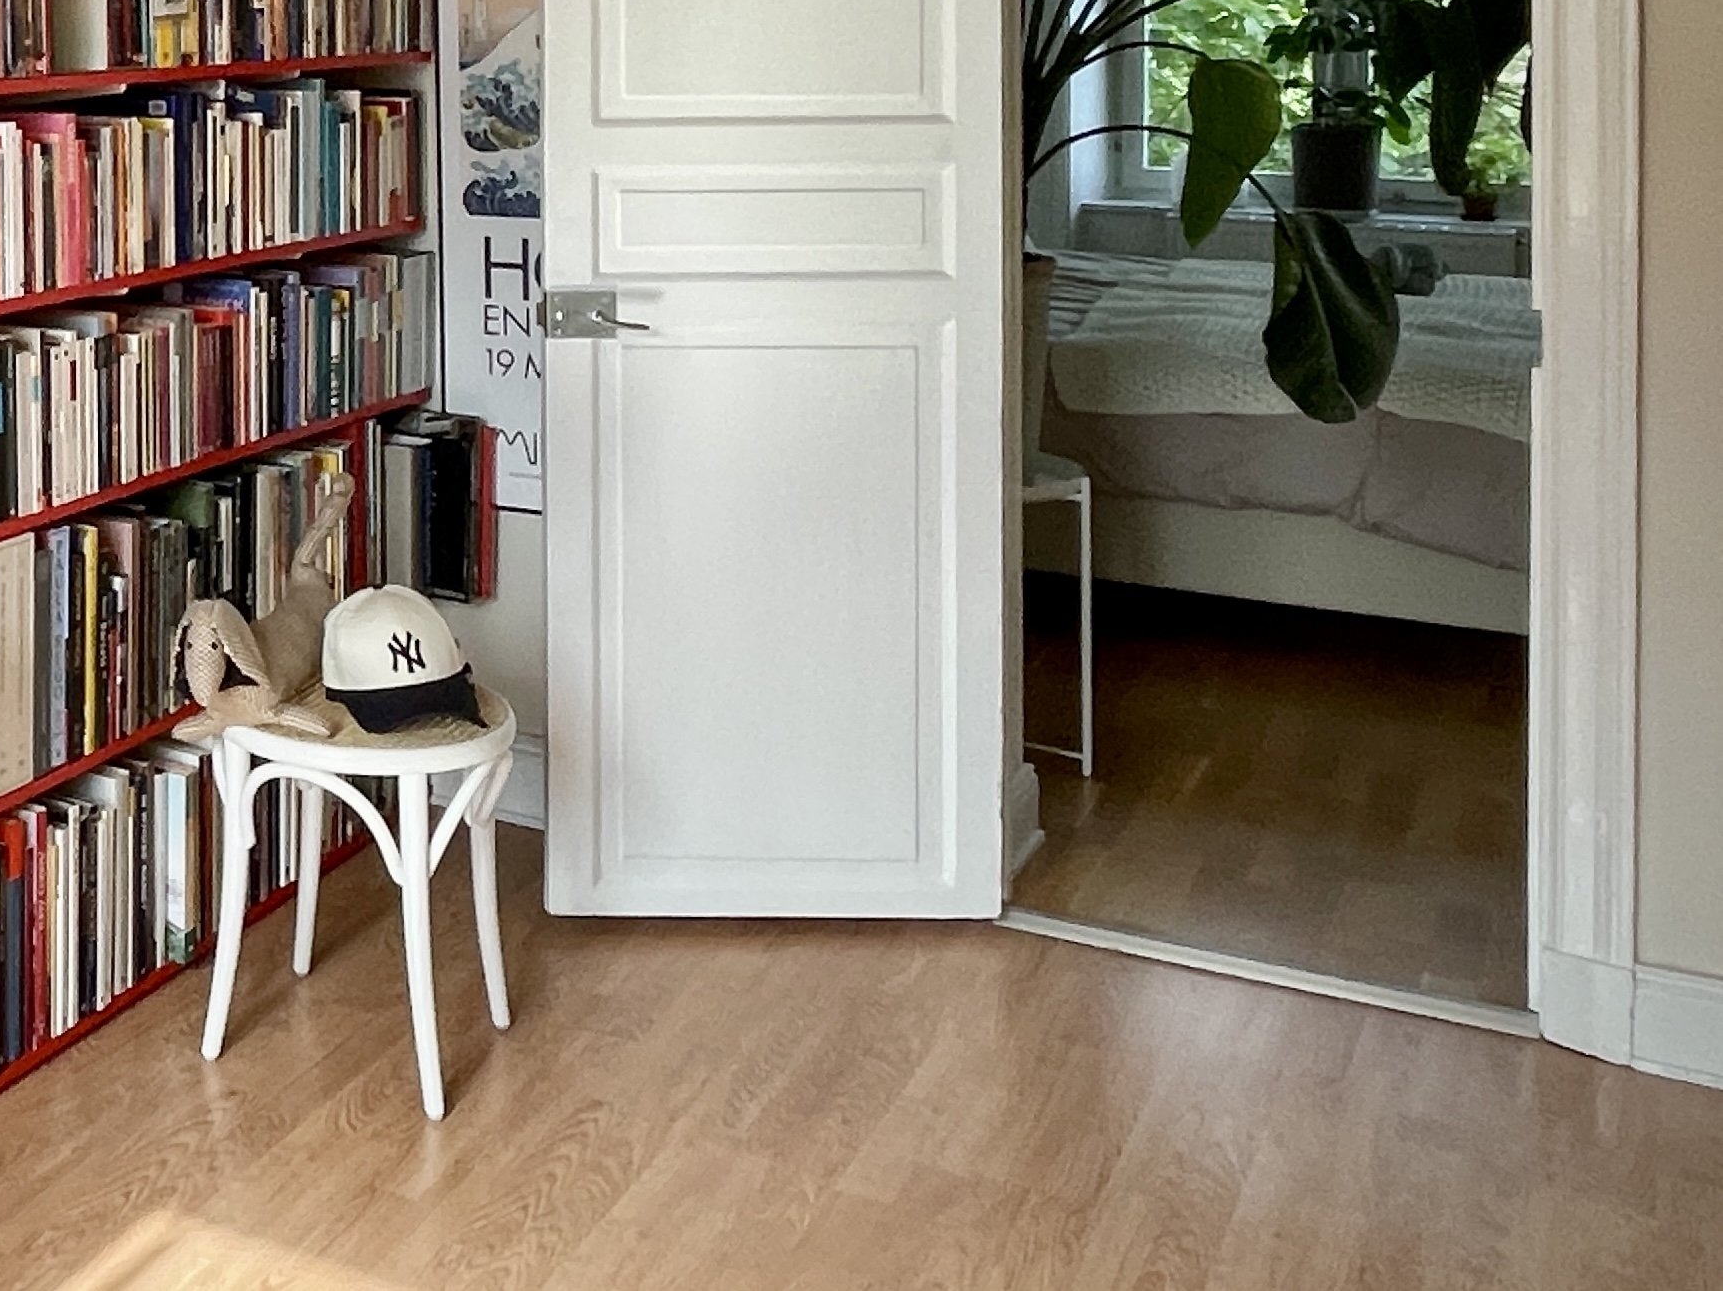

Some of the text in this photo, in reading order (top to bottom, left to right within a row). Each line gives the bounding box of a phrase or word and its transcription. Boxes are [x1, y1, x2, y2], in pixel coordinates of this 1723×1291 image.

[484, 235, 543, 302] H
[484, 305, 532, 339] EN
[486, 348, 516, 378] 19
[387, 630, 426, 674] NY
